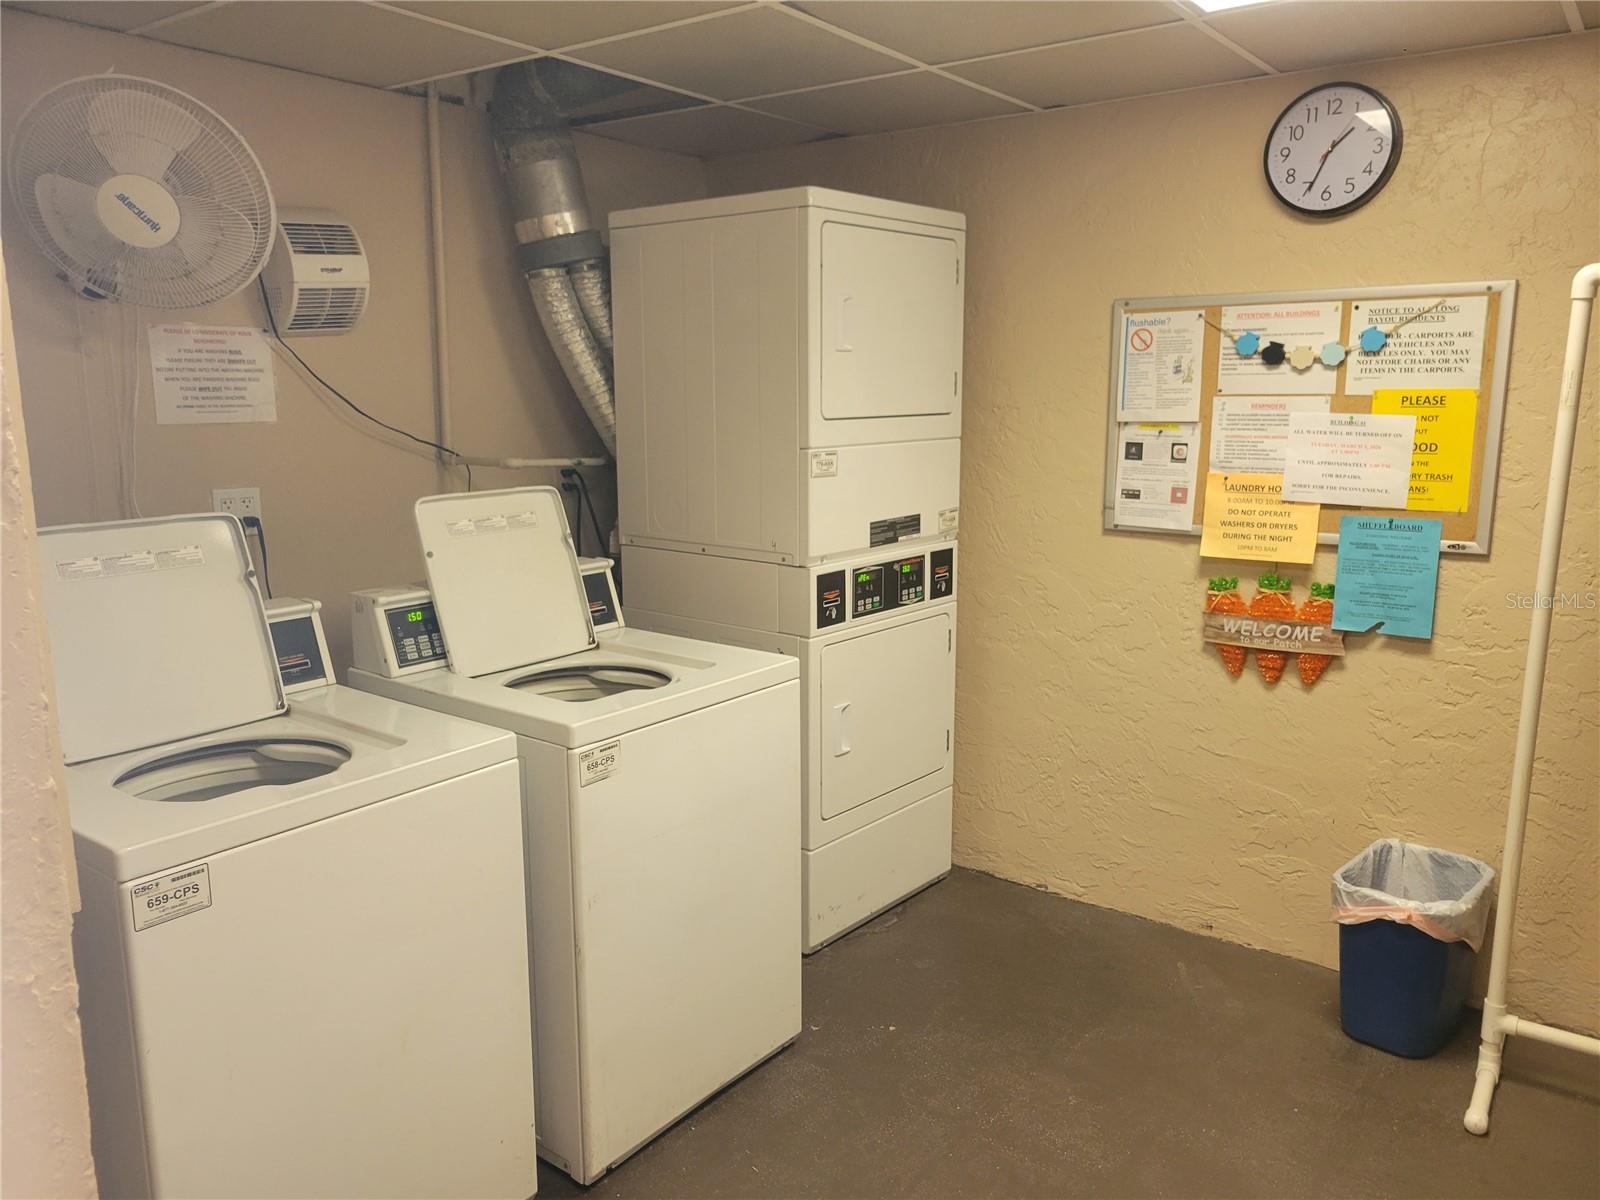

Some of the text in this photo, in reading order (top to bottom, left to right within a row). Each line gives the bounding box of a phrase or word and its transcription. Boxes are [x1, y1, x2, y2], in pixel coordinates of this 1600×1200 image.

[1326, 98, 1343, 115] 12
[1306, 107, 1318, 123] 11
[1290, 125, 1304, 141] 10
[1372, 137, 1384, 154] 3
[1280, 146, 1291, 163] 9
[1362, 160, 1373, 176] 4
[1285, 168, 1296, 184] 8
[1302, 181, 1314, 197] 7
[1344, 177, 1356, 194] 5
[1320, 185, 1332, 201] 6
[1368, 306, 1399, 315] NOTICE
[1403, 305, 1414, 314] TO
[1434, 304, 1460, 313] LONG
[1129, 318, 1171, 328] flushable?
[1368, 316, 1398, 324] BAYOU
[1408, 332, 1454, 340] CARPORTS
[1400, 349, 1426, 357] ONLY.
[1401, 395, 1447, 406] PLEASE
[1420, 415, 1440, 423] NOT
[1317, 460, 1367, 468] APPROXIMATELY
[1425, 473, 1454, 481] TRASH
[1224, 484, 1266, 493] LAUNDRY
[1408, 486, 1429, 494] ANS!
[1258, 510, 1292, 518] OPERATE
[1220, 520, 1255, 529] WASHERS
[1269, 523, 1298, 531] DRYERS
[1357, 521, 1424, 532] SHUFFLBOARD
[1222, 532, 1293, 543] DURING THE NIGHT
[1223, 618, 1325, 642] WELCOME
[1274, 638, 1302, 649] Patch
[586, 754, 615, 772] 658-CPS
[134, 883, 154, 895] CSC
[146, 883, 200, 909] 659-CPS
